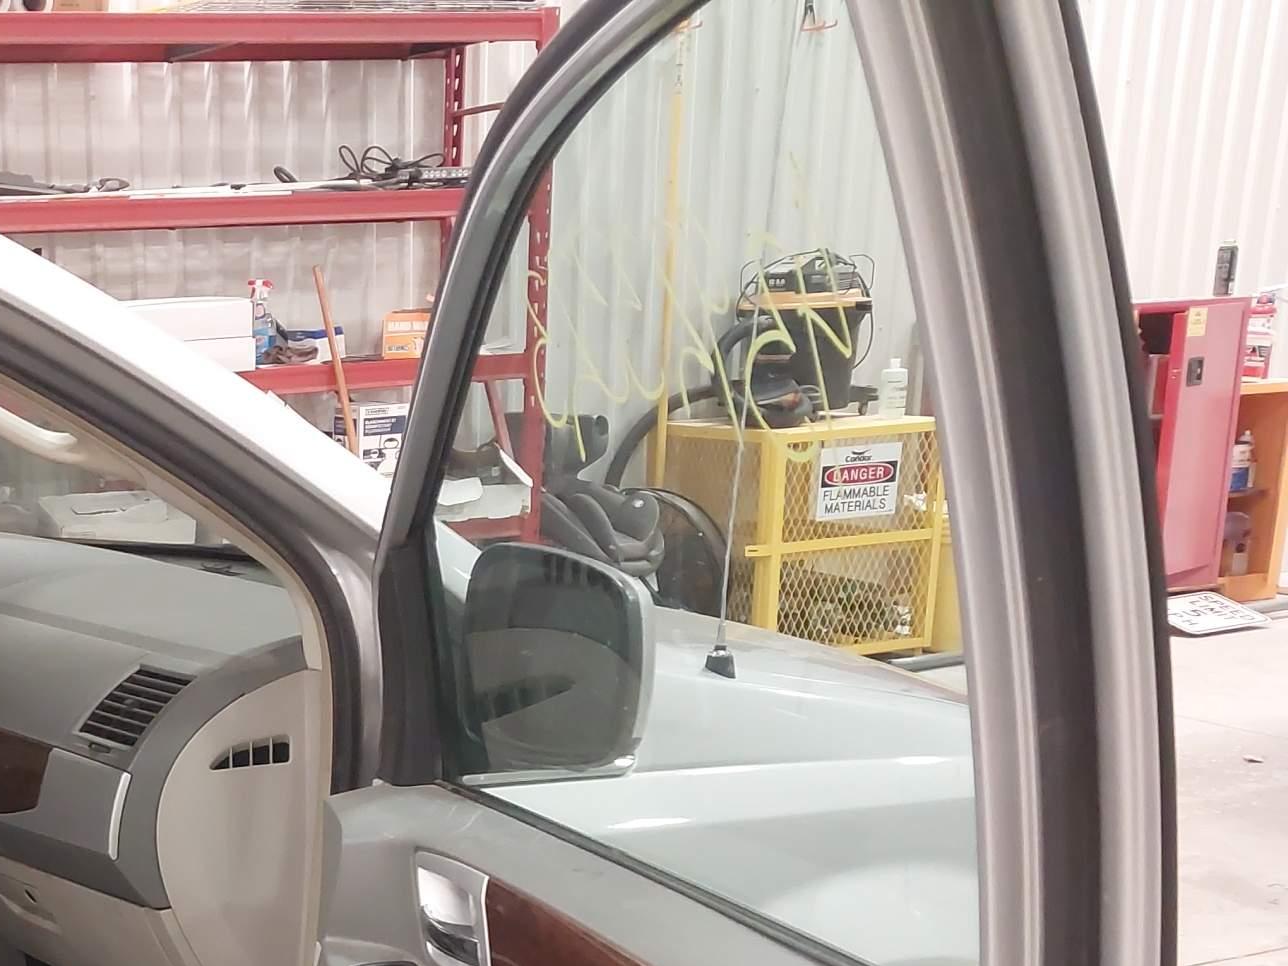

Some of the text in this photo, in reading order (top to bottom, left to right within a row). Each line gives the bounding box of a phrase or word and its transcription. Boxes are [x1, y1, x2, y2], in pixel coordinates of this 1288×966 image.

[833, 466, 885, 482] DANGER
[823, 485, 890, 501] FLAMMABLE
[824, 498, 886, 514] MATERIALS
[1189, 599, 1238, 620] LIMIT
[1198, 595, 1256, 621] SPEED
